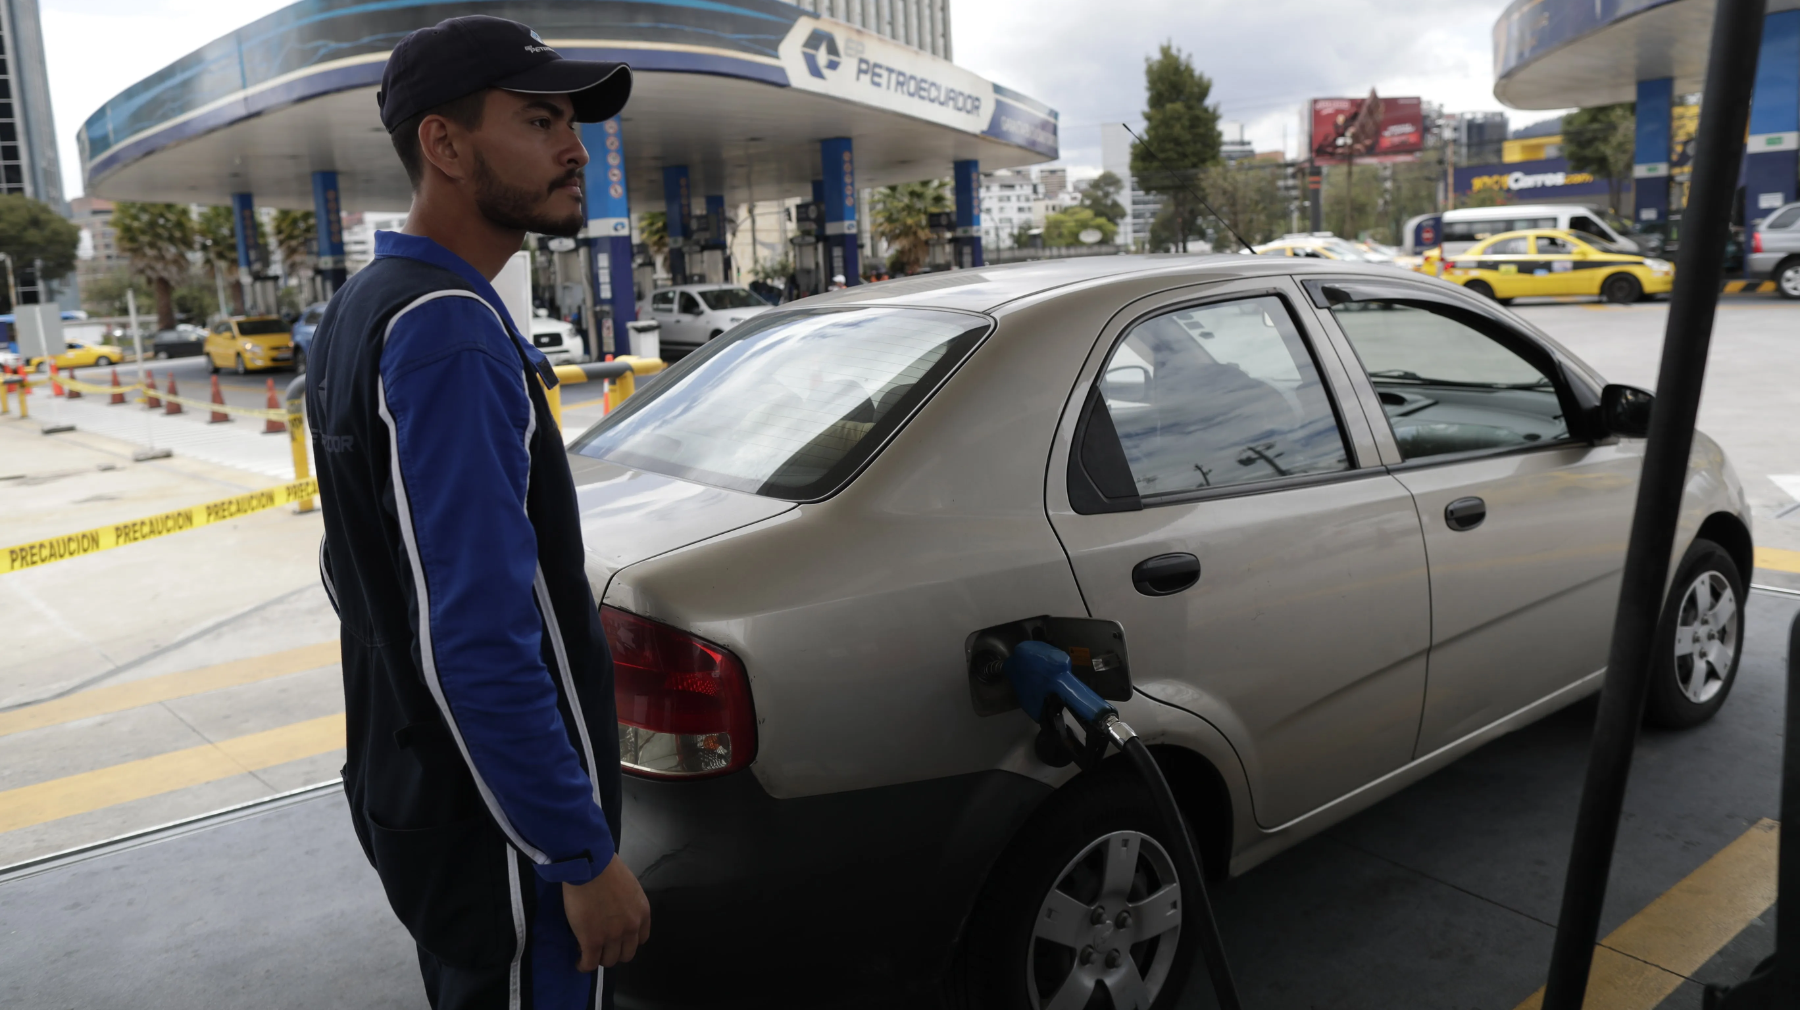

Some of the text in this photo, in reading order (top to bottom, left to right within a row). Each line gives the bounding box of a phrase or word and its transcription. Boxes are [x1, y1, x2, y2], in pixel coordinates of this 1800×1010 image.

[857, 57, 982, 117] PETROECUADOR
[9, 531, 100, 570] PRECAUCION
[115, 510, 193, 546] PRECAUCION
[206, 490, 275, 523] PRECAUCION
